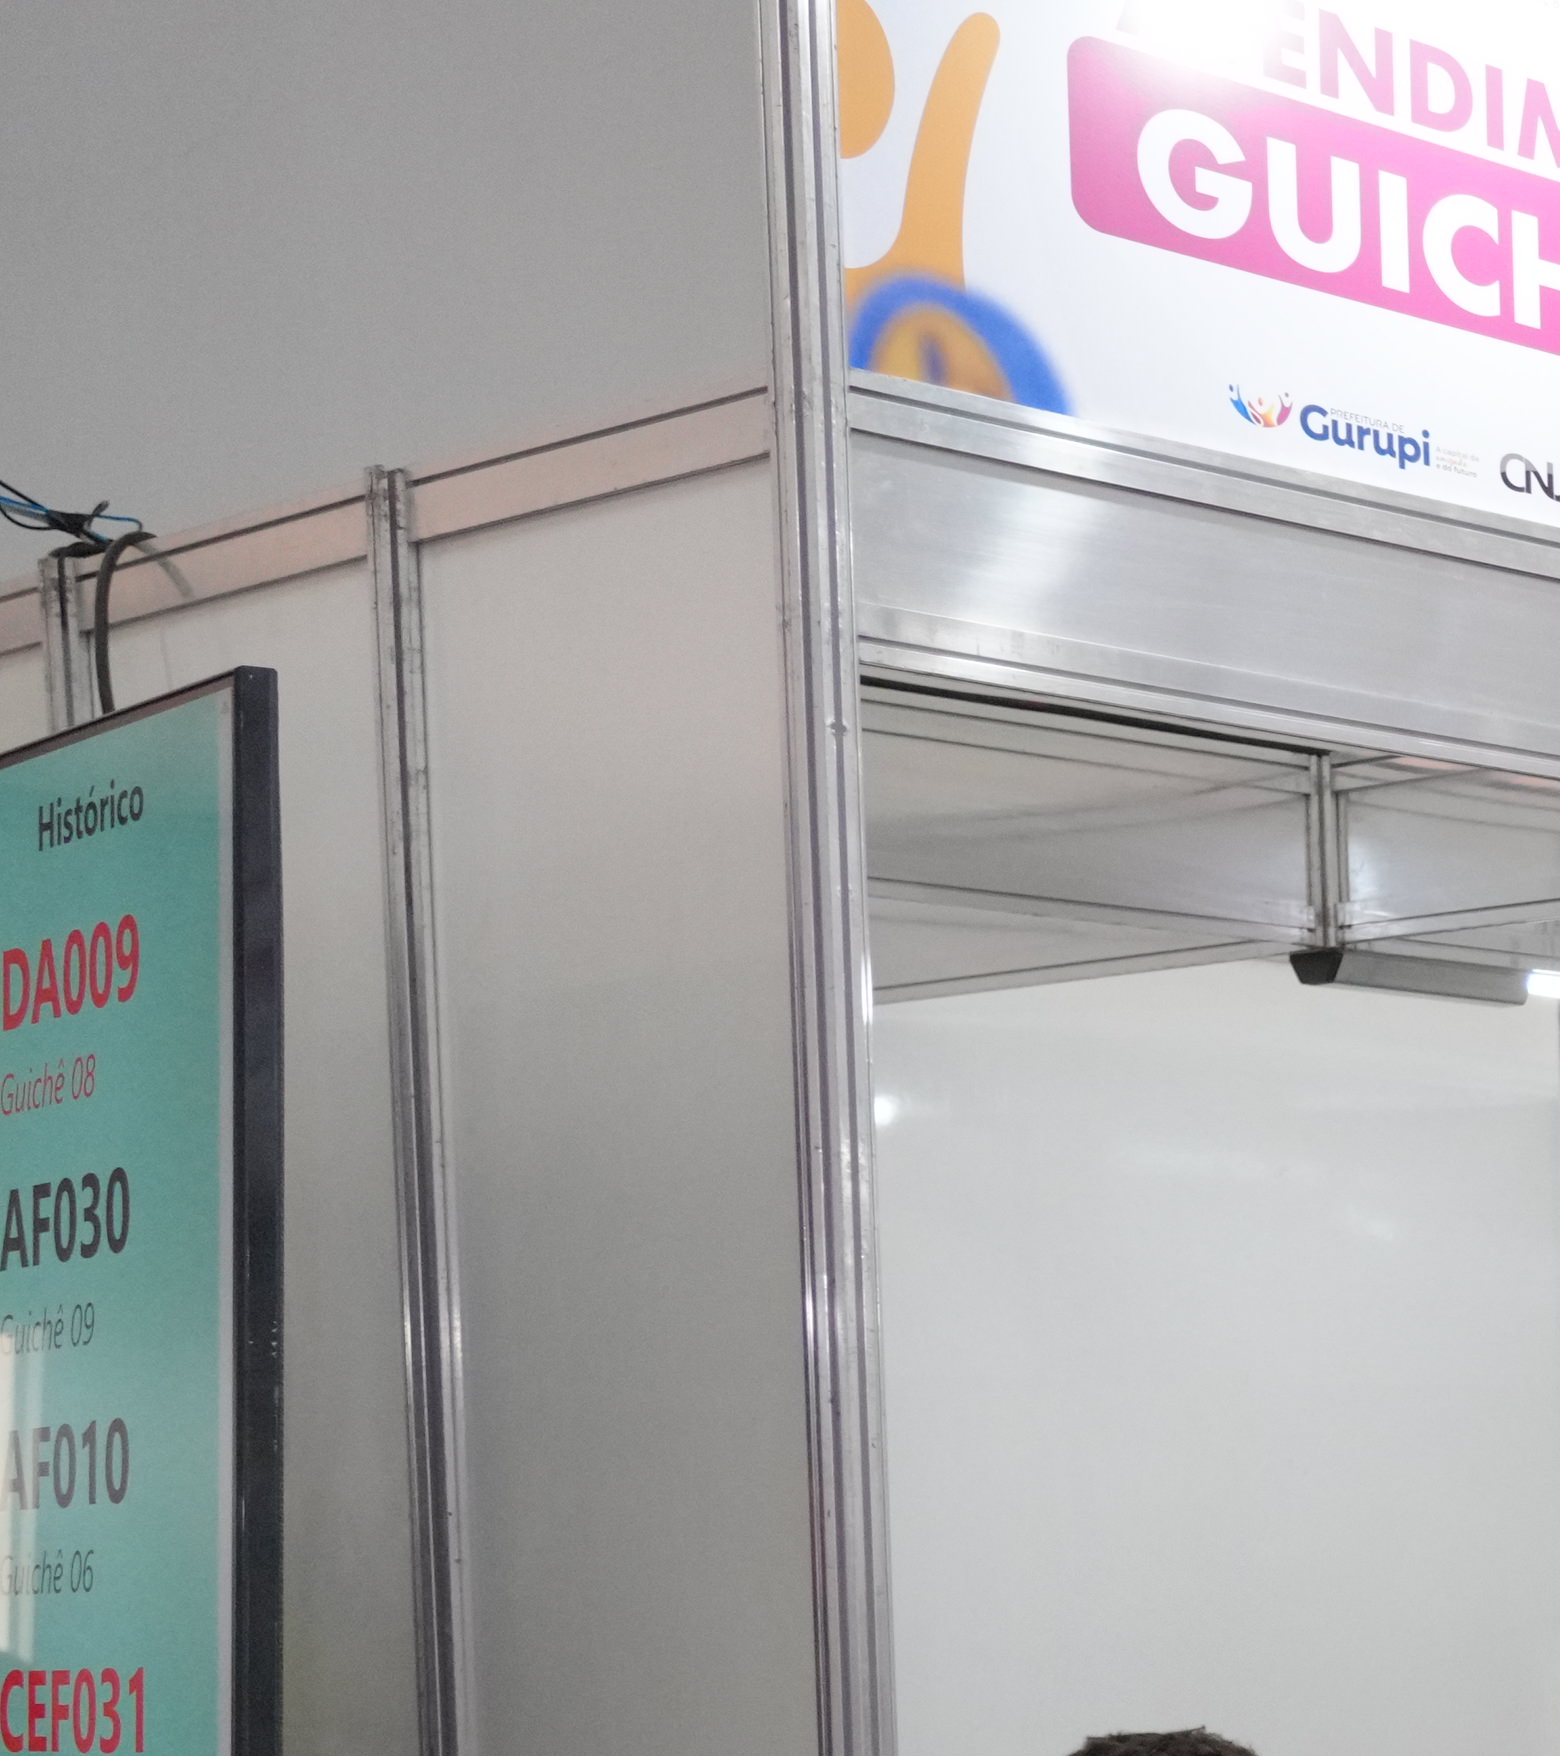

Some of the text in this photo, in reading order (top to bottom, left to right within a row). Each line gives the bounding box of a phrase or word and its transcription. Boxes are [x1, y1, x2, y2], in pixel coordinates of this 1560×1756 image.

[1300, 404, 1430, 470] Gurupi
[1330, 407, 1405, 433] PREFEITURA DE
[38, 778, 144, 852] Histórico
[2, 914, 140, 1032] DA009
[0, 1053, 96, 1117] Guichê 08
[0, 1166, 130, 1272] AF030
[0, 1301, 95, 1357] Guichê 09
[0, 1416, 130, 1512] AF010
[0, 1548, 95, 1599] Guichê 06
[0, 1665, 145, 1755] CEF031
